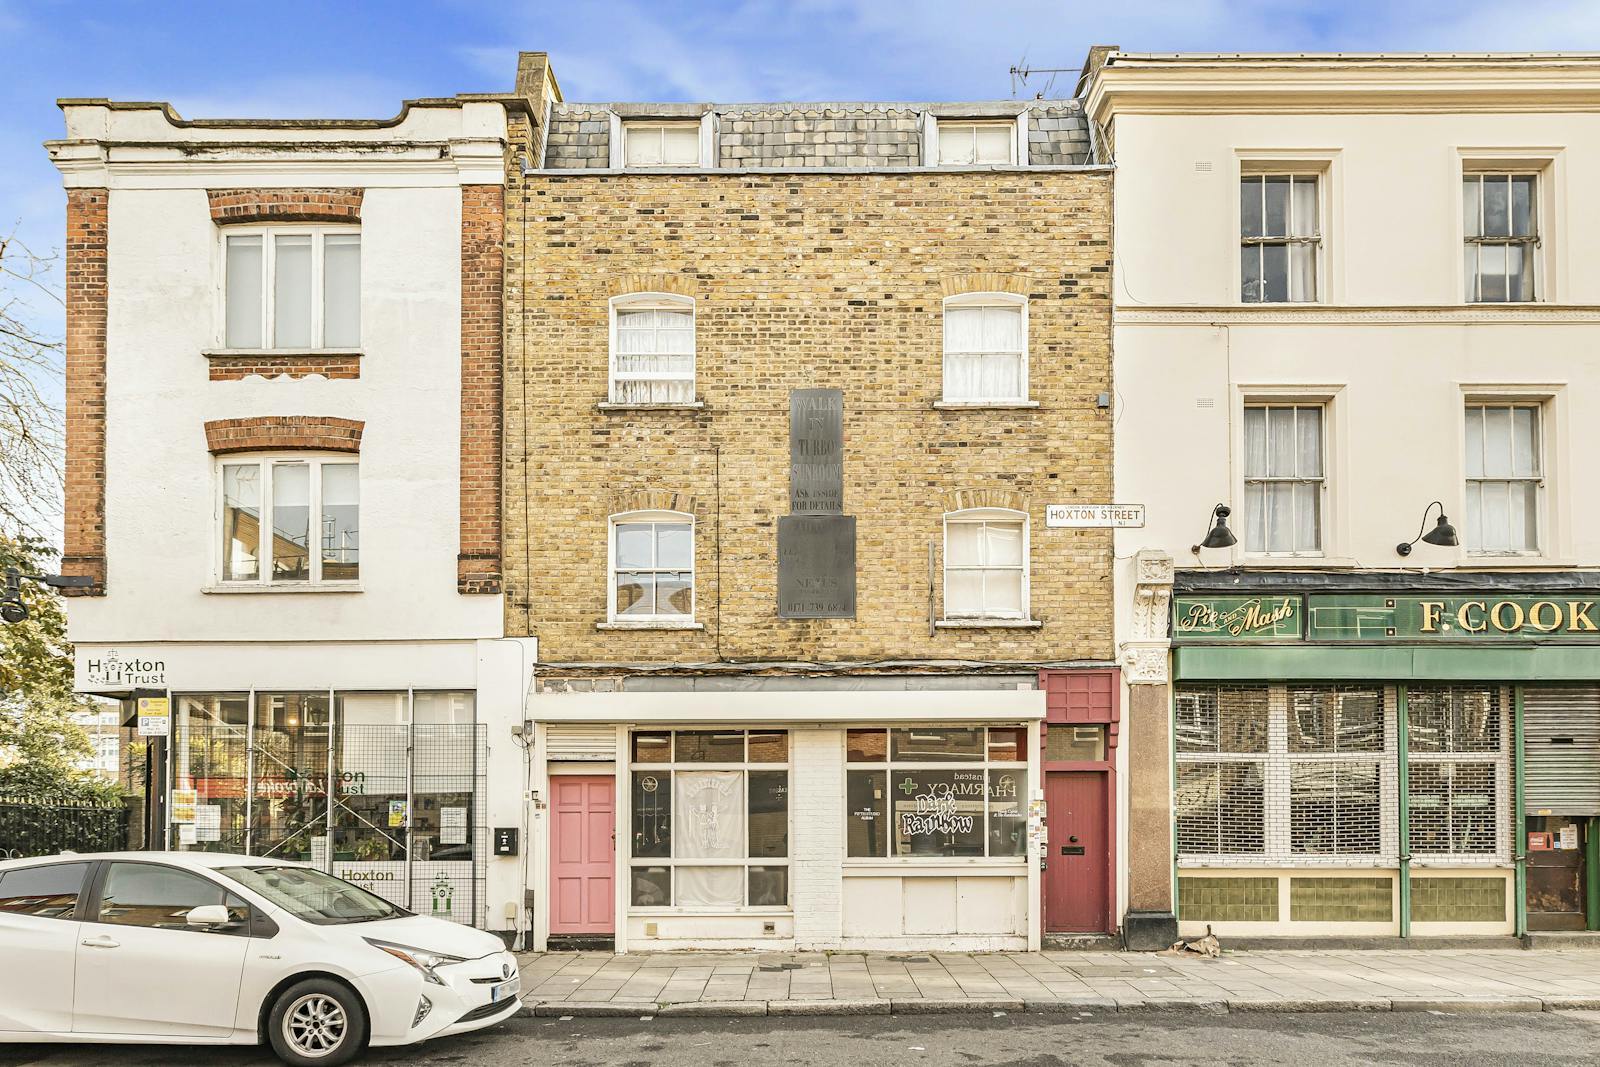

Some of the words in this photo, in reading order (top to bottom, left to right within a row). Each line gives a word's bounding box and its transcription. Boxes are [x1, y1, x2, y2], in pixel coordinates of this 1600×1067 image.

[794, 397, 836, 410] WALK
[798, 439, 835, 456] TURBO
[796, 489, 809, 498] ASK
[792, 501, 807, 510] FOR
[809, 501, 842, 510] DETAILS
[1050, 510, 1095, 520] HOXTON
[1101, 510, 1140, 520] STREET
[1181, 603, 1218, 631] Pie
[1229, 599, 1293, 636] Mash
[125, 673, 165, 684] Trust
[342, 869, 394, 881] Hoxton
